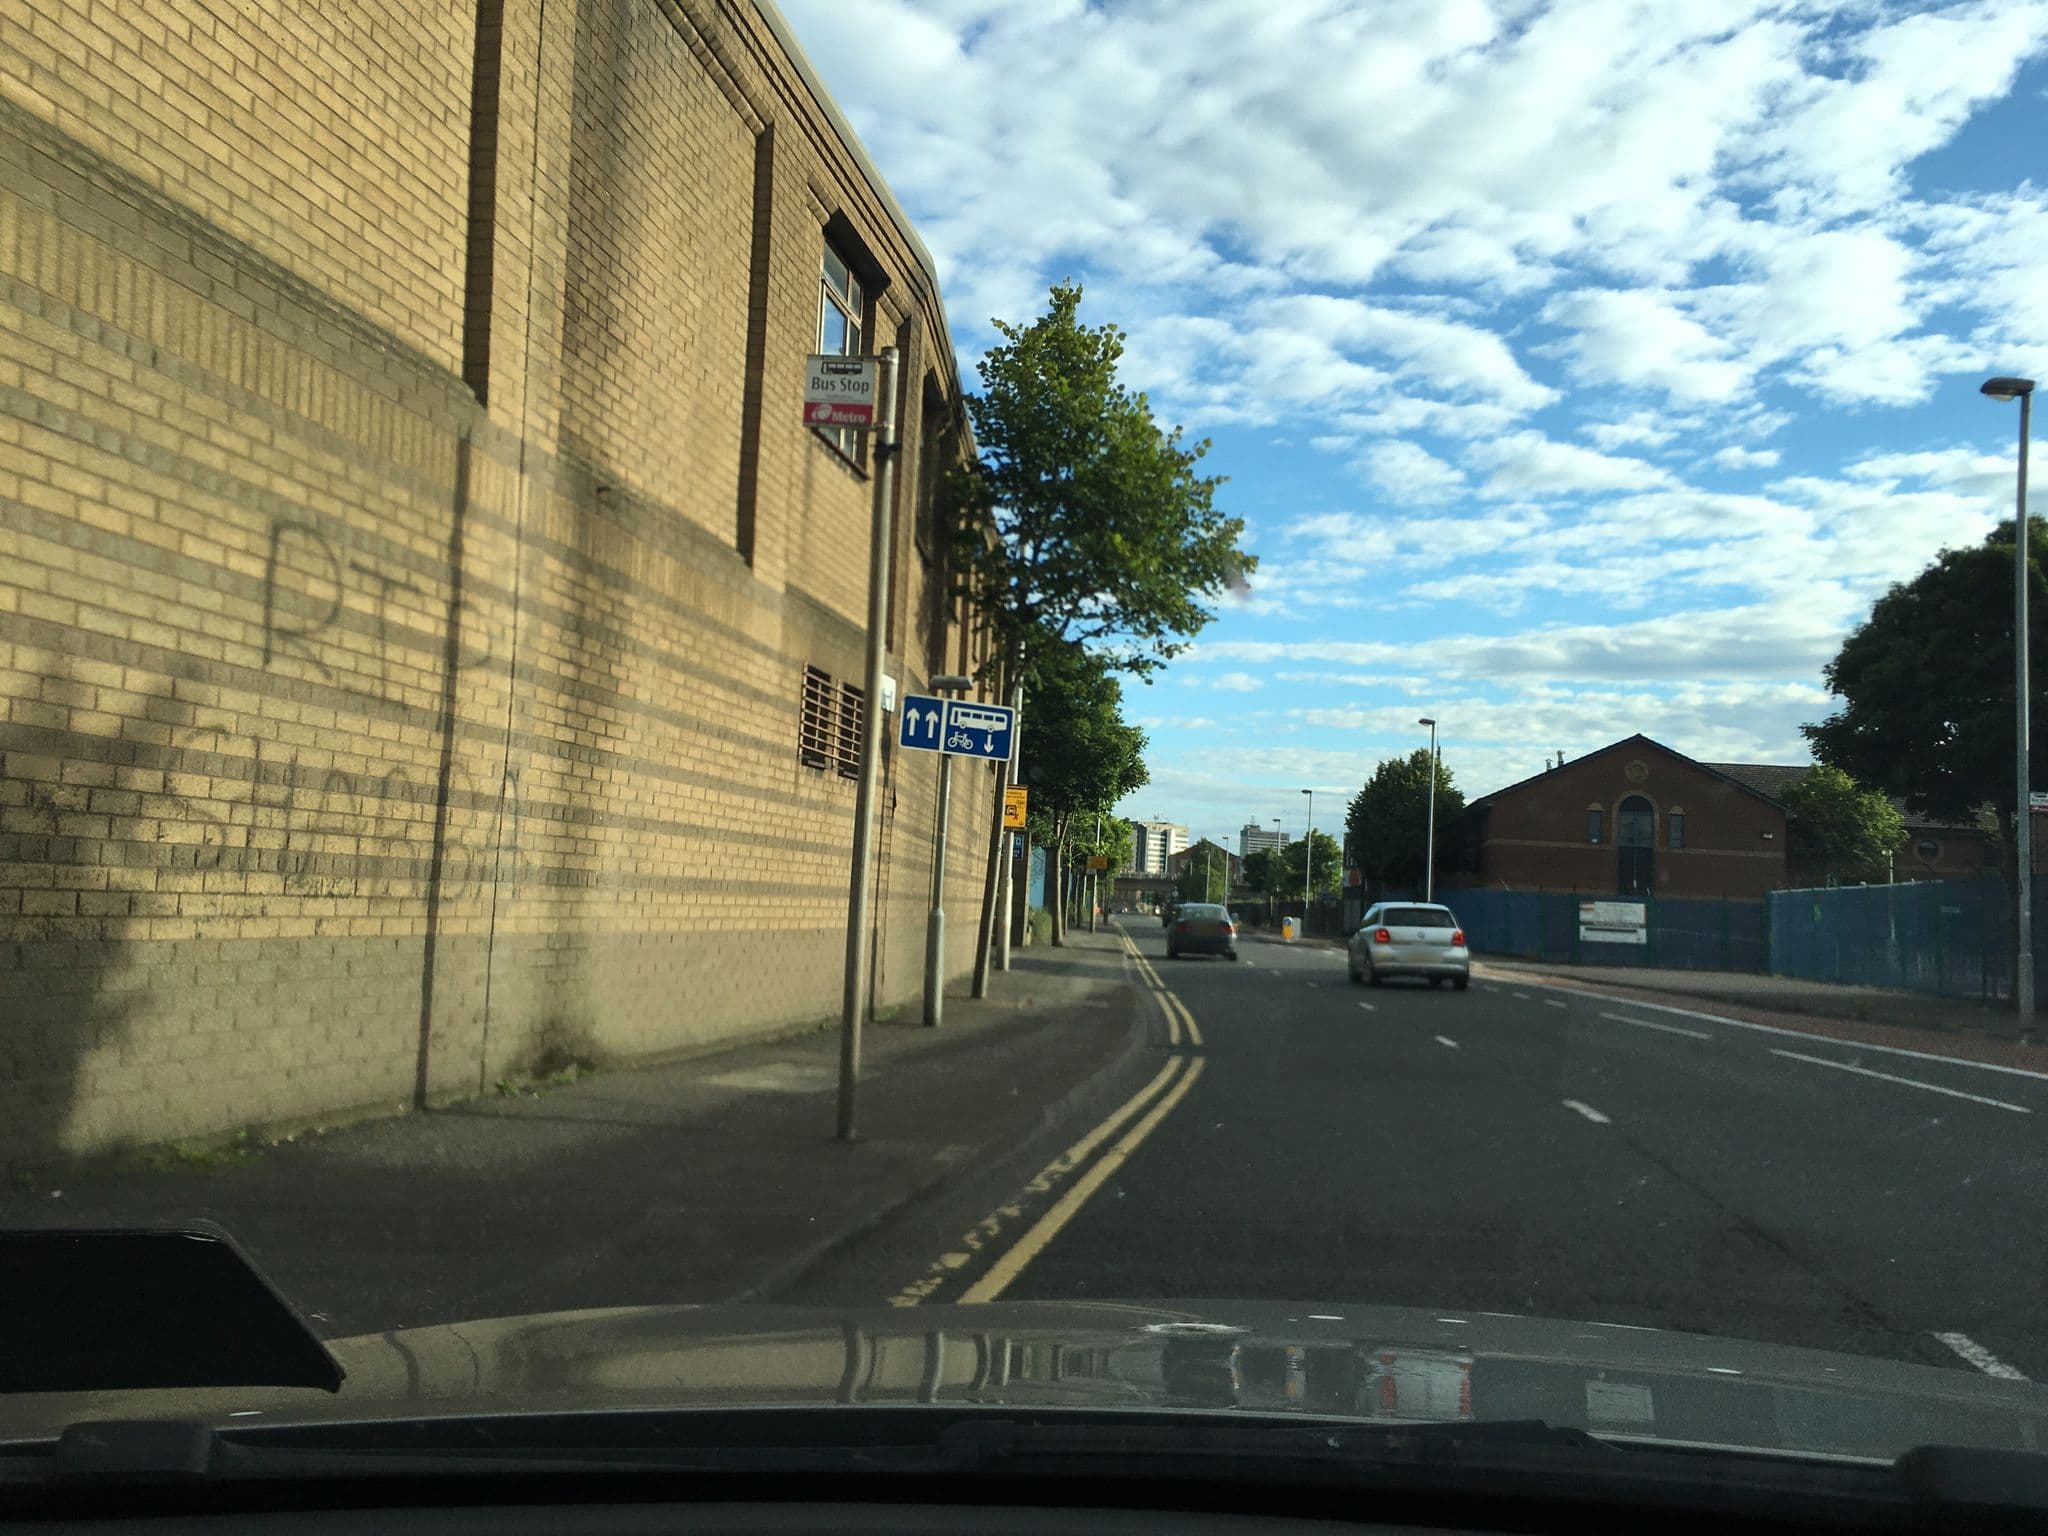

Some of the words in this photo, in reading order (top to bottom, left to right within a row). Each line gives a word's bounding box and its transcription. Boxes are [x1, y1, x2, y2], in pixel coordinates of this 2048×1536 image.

[811, 376, 836, 391] Bus
[840, 377, 870, 395] Stop
[831, 410, 866, 423] Metro
